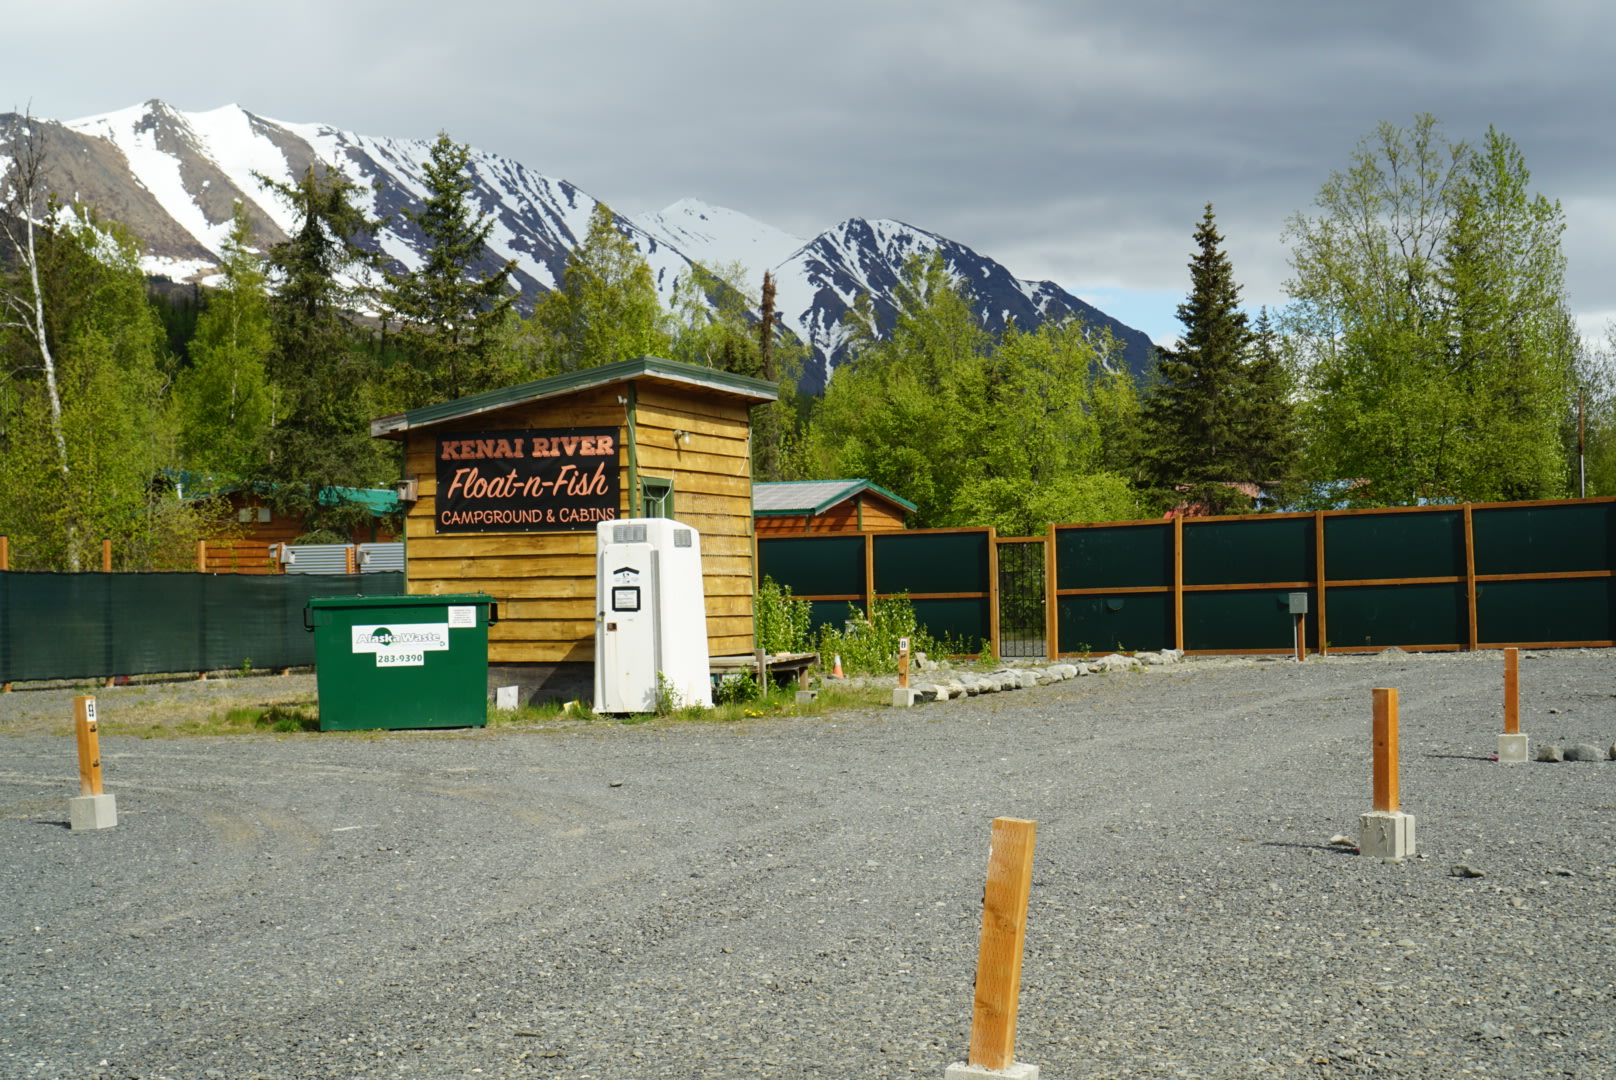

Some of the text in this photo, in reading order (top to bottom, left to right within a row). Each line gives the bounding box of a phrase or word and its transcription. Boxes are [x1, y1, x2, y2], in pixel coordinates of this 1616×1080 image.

[441, 435, 615, 460] KENAI RIVER
[447, 461, 609, 499] Float-n-Fish
[441, 507, 615, 525] CAMPGROUND & CABINS
[356, 631, 441, 644] Alaska Waste
[377, 653, 423, 663] 283-9390
